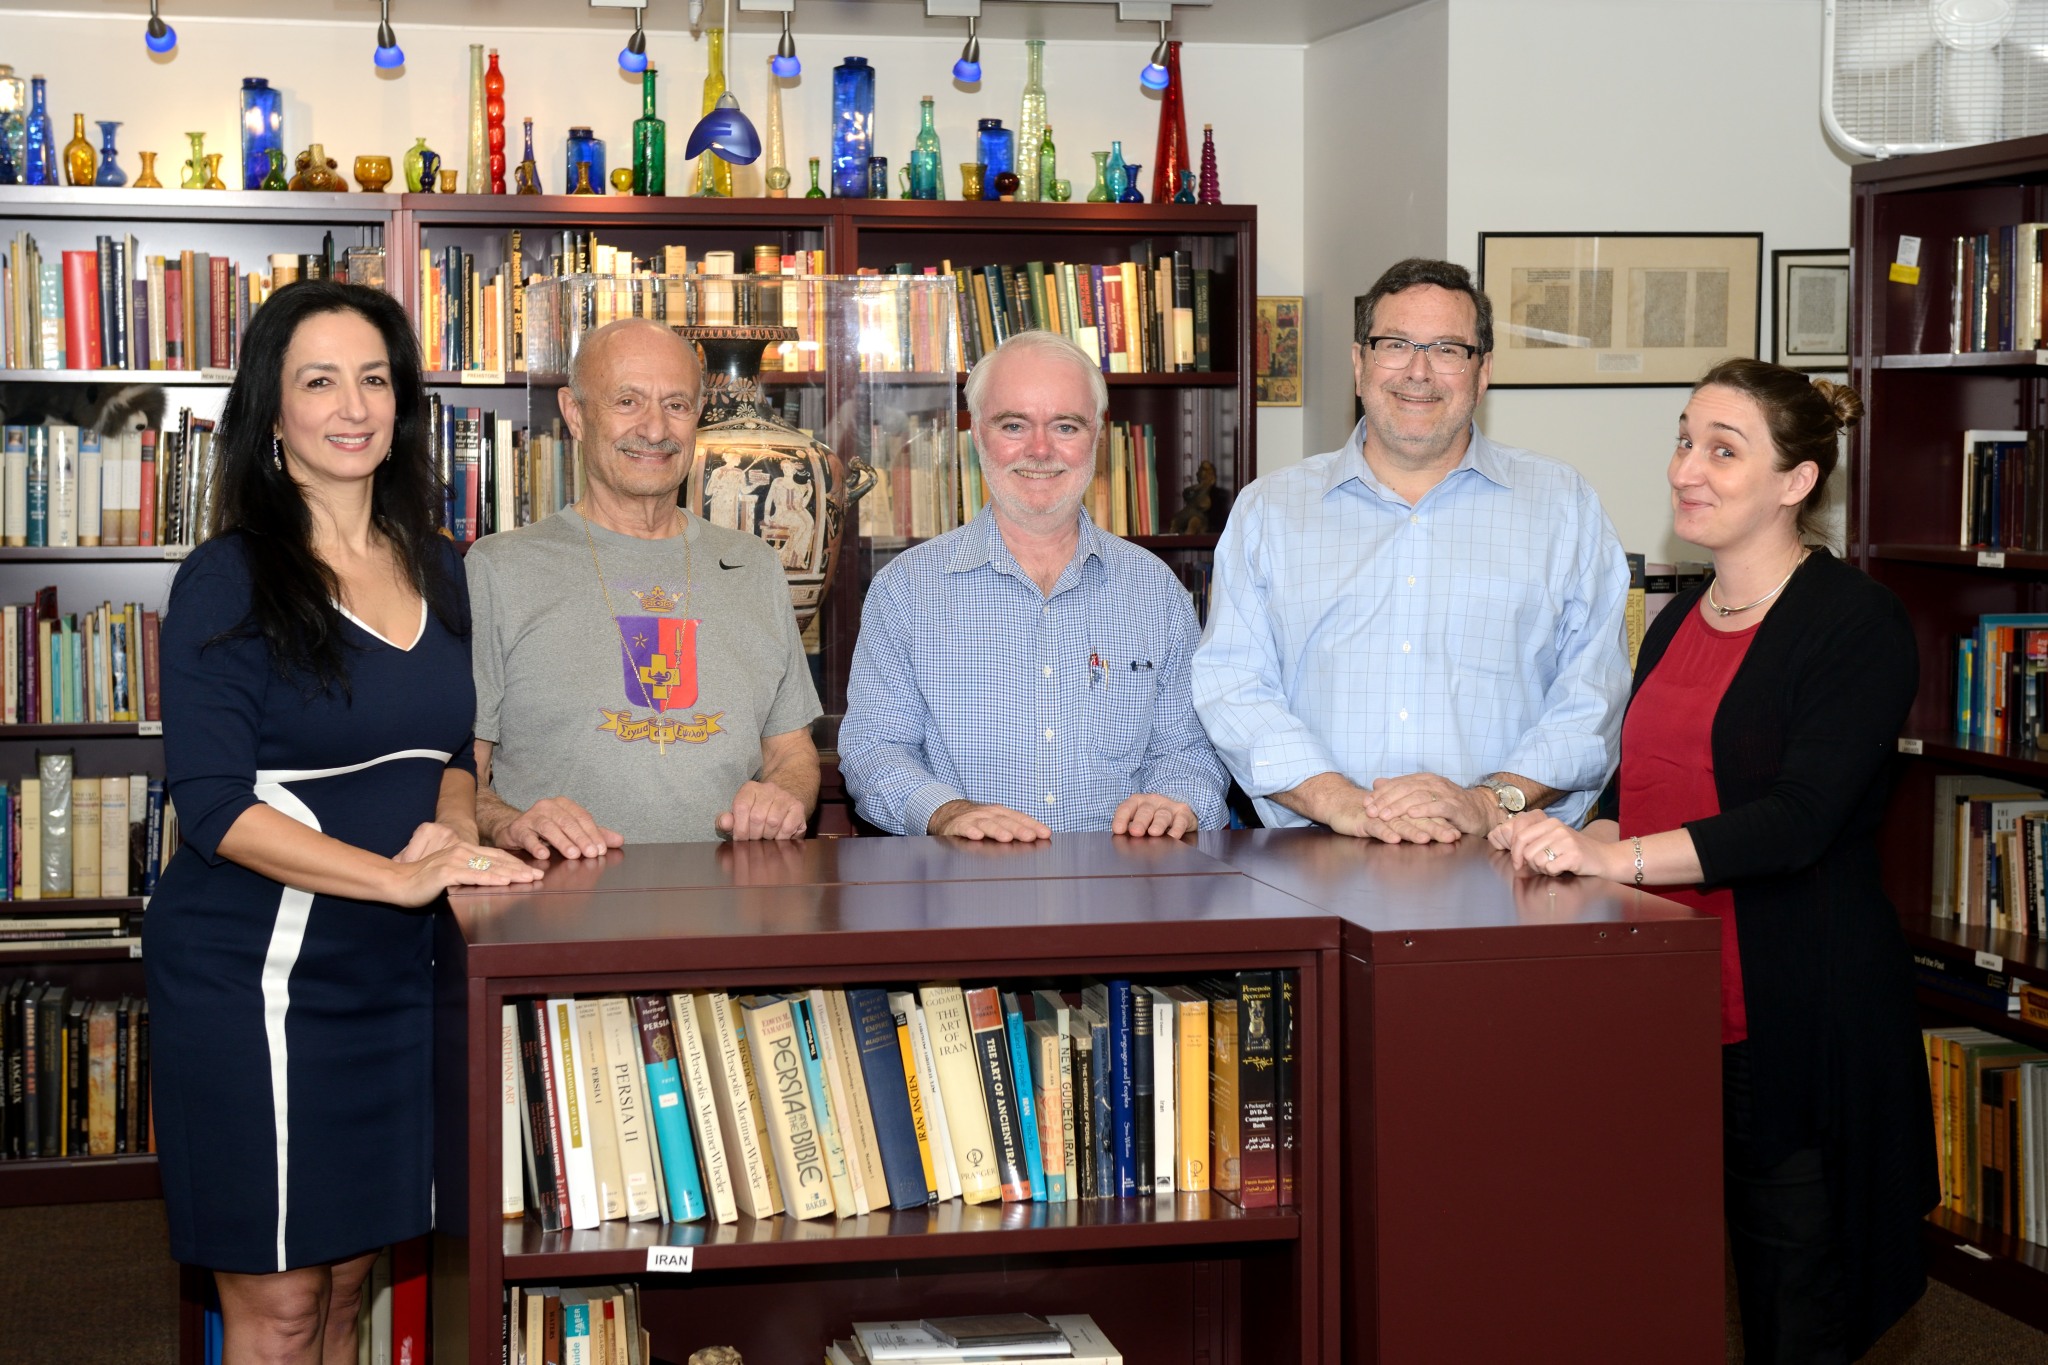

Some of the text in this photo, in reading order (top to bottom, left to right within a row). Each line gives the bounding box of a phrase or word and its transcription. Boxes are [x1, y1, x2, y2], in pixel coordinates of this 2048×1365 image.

[513, 232, 522, 334] The Ancient Near East
[1635, 594, 1643, 608] The
[1626, 593, 1636, 659] DICTIONARY
[926, 994, 962, 1007] GODARD
[1242, 984, 1272, 993] Persepolis
[1242, 992, 1271, 1004] Recreated
[642, 1005, 667, 1016] Heritage
[862, 1012, 889, 1025] PERSIAN
[936, 1008, 960, 1020] THE
[1120, 987, 1129, 1028] Indo-Iranian
[643, 1019, 670, 1032] PERSIA
[762, 1016, 781, 1028] EDWIN
[864, 1021, 890, 1033] EMPIRE
[940, 1020, 962, 1032] ART
[939, 1042, 968, 1057] IRAN
[944, 1033, 960, 1043] OF
[1060, 1033, 1071, 1041] A
[1120, 1028, 1131, 1066] Languages
[26, 1008, 37, 1095] AFRICAN ROCK ART
[1061, 1046, 1072, 1074] NEW
[502, 1025, 515, 1106] PARTHIAN ART
[769, 1035, 807, 1116] PERSIA
[1018, 1064, 1028, 1089] People
[1122, 1066, 1130, 1080] and
[12, 1055, 22, 1104] LASCAUX
[537, 1008, 547, 1046] MESOPOTAMIA
[546, 1090, 554, 1116] PARTHIAN
[551, 1128, 559, 1154] SASANIAN
[592, 1066, 601, 1098] PERSIA
[713, 993, 762, 1190] Flames over Persepolis Mortimer Wheeler
[565, 1053, 577, 1105] ARCHAEOLOGY
[572, 1117, 580, 1136] ELAM
[615, 1063, 639, 1143] PERSIA II
[679, 993, 727, 1195] Flames over Persepolis Mortimer Wheeler
[1121, 1080, 1132, 1109] Peoples
[908, 1075, 928, 1142] IRAN ANCIEN
[987, 1038, 1017, 1176] THE ART OF ANCIENT IRAN
[1022, 1097, 1032, 1117] IRAN
[788, 1115, 799, 1132] THE
[797, 1113, 809, 1130] AND
[790, 1129, 823, 1188] BIBLE
[1064, 1138, 1075, 1167] IRAN
[805, 1199, 828, 1211] BAKER
[655, 1254, 688, 1266] IRAN
